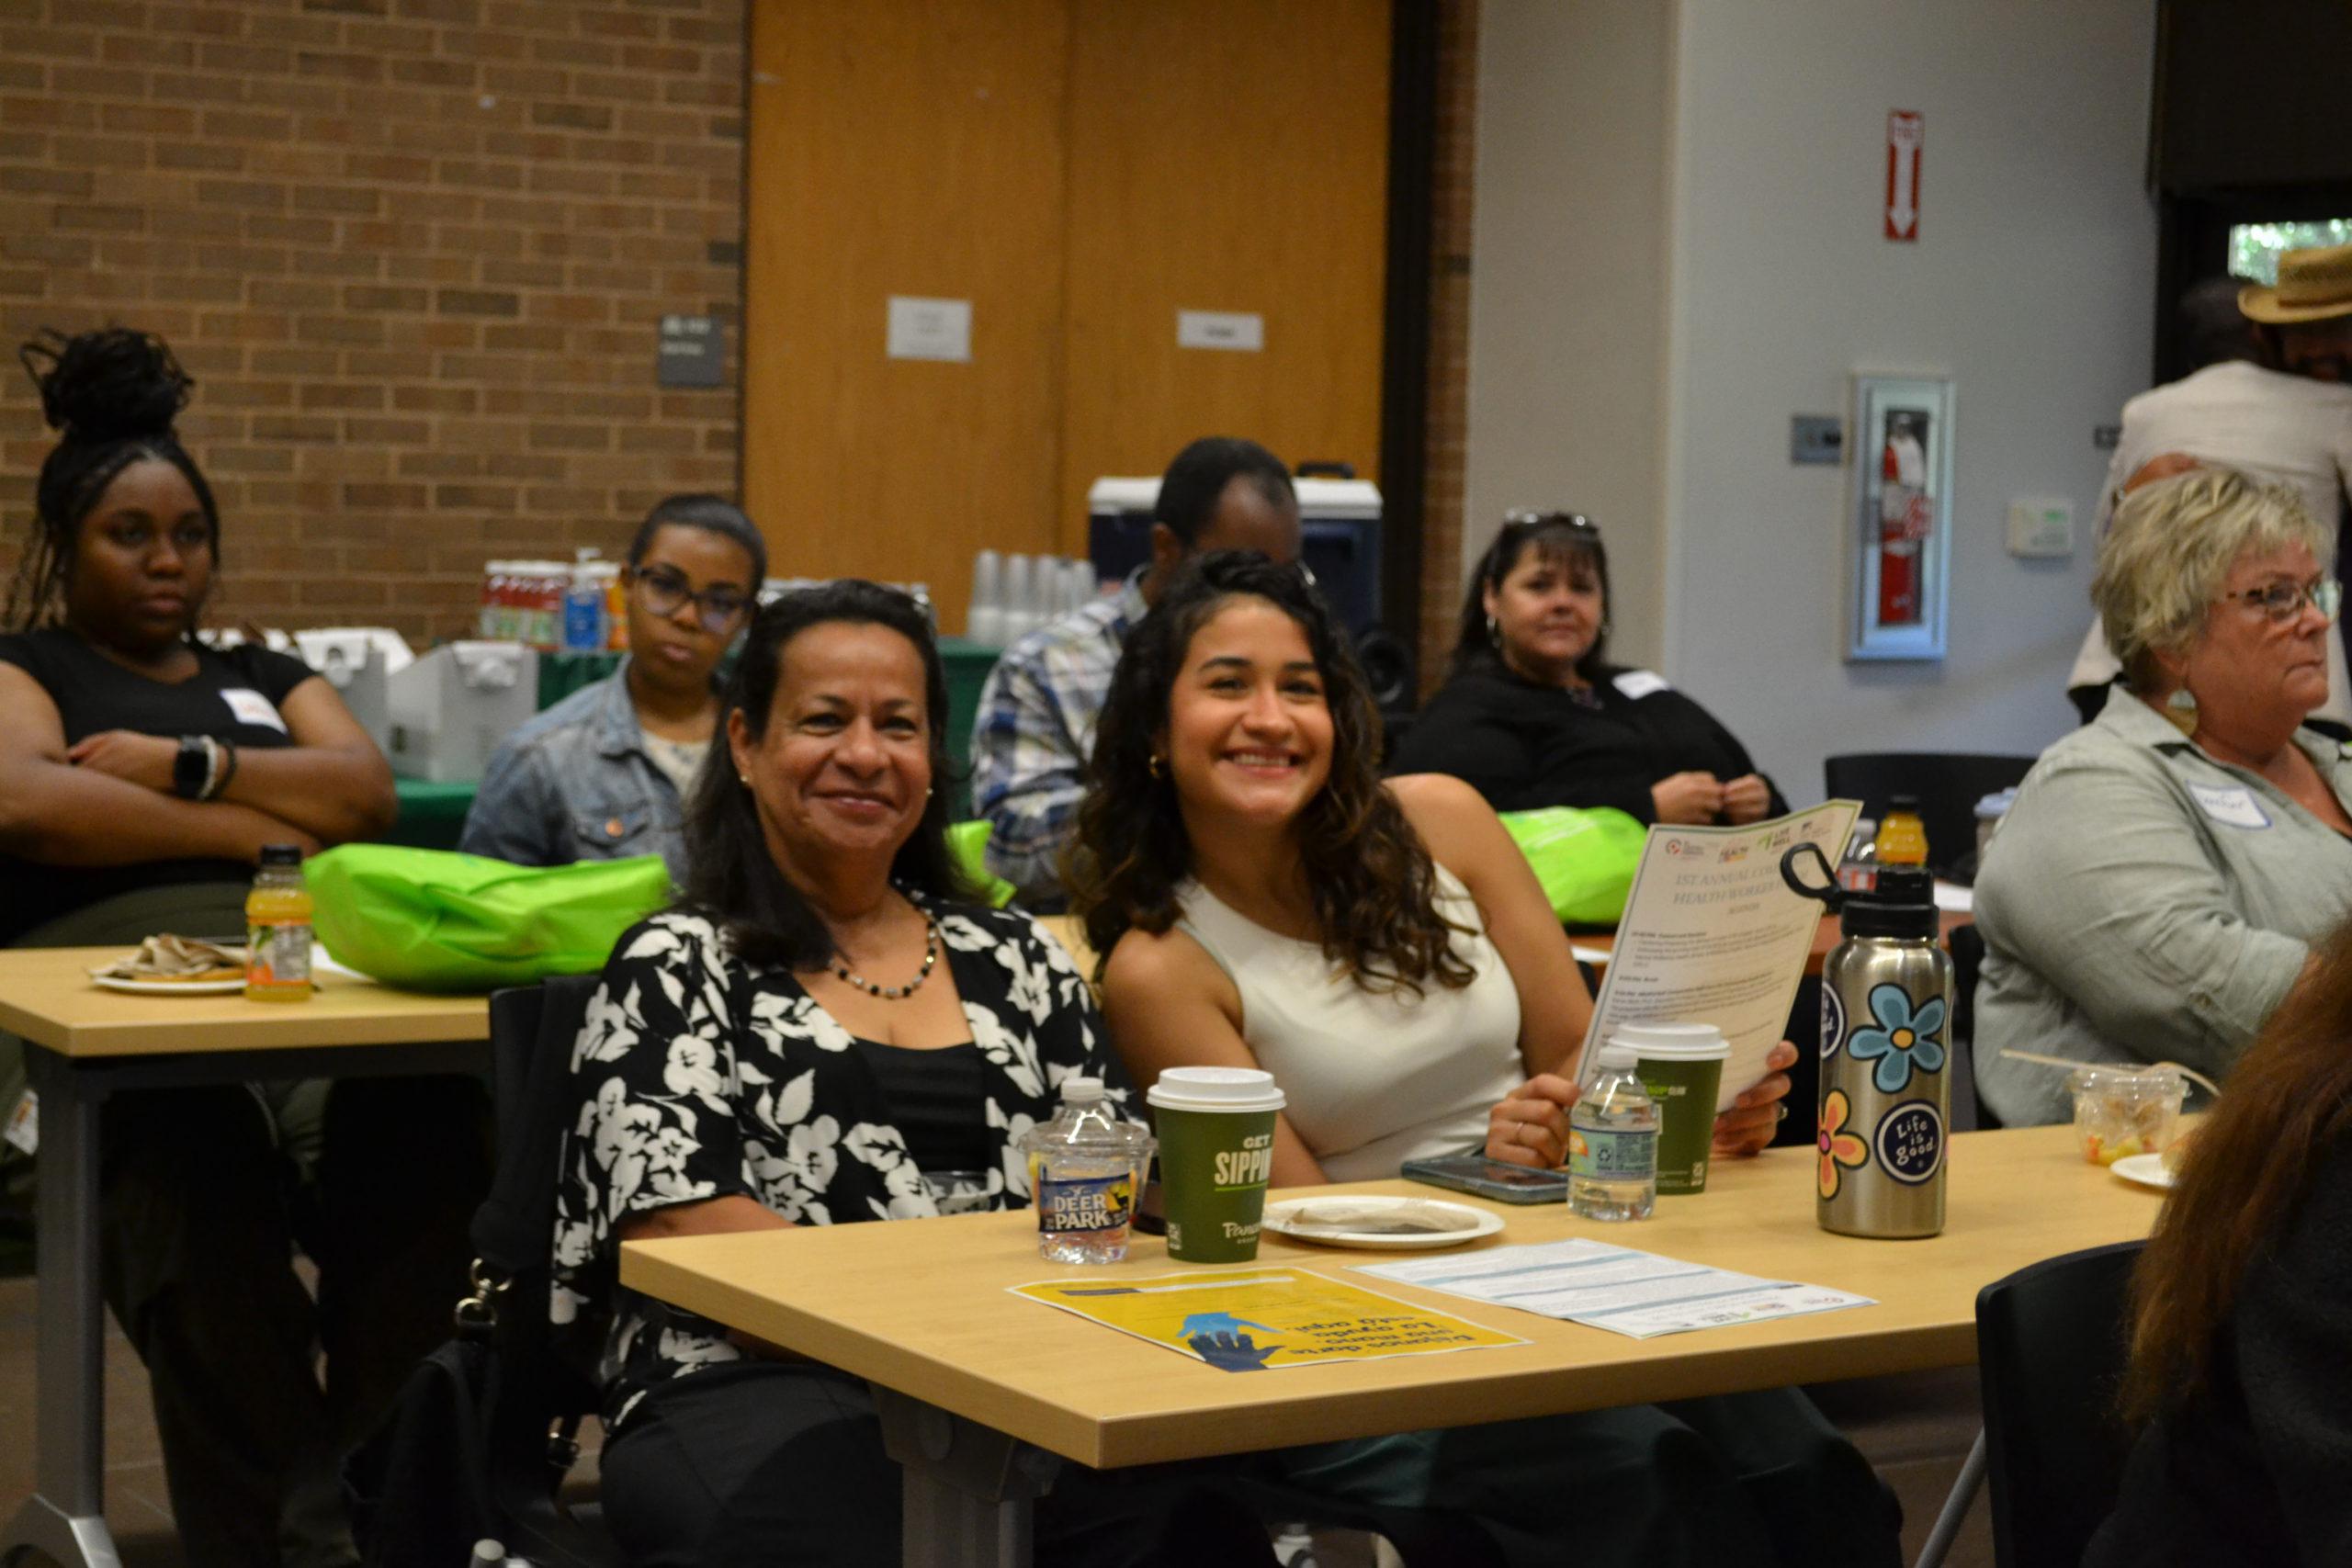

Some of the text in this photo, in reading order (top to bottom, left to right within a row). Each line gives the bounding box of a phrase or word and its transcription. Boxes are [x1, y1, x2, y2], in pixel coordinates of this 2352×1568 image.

[1896, 1115, 1928, 1139] Life
[1243, 1134, 1271, 1149] GET
[1911, 1133, 1924, 1146] is
[1054, 1193, 1107, 1213] DEER
[1055, 1209, 1110, 1230] PARK
